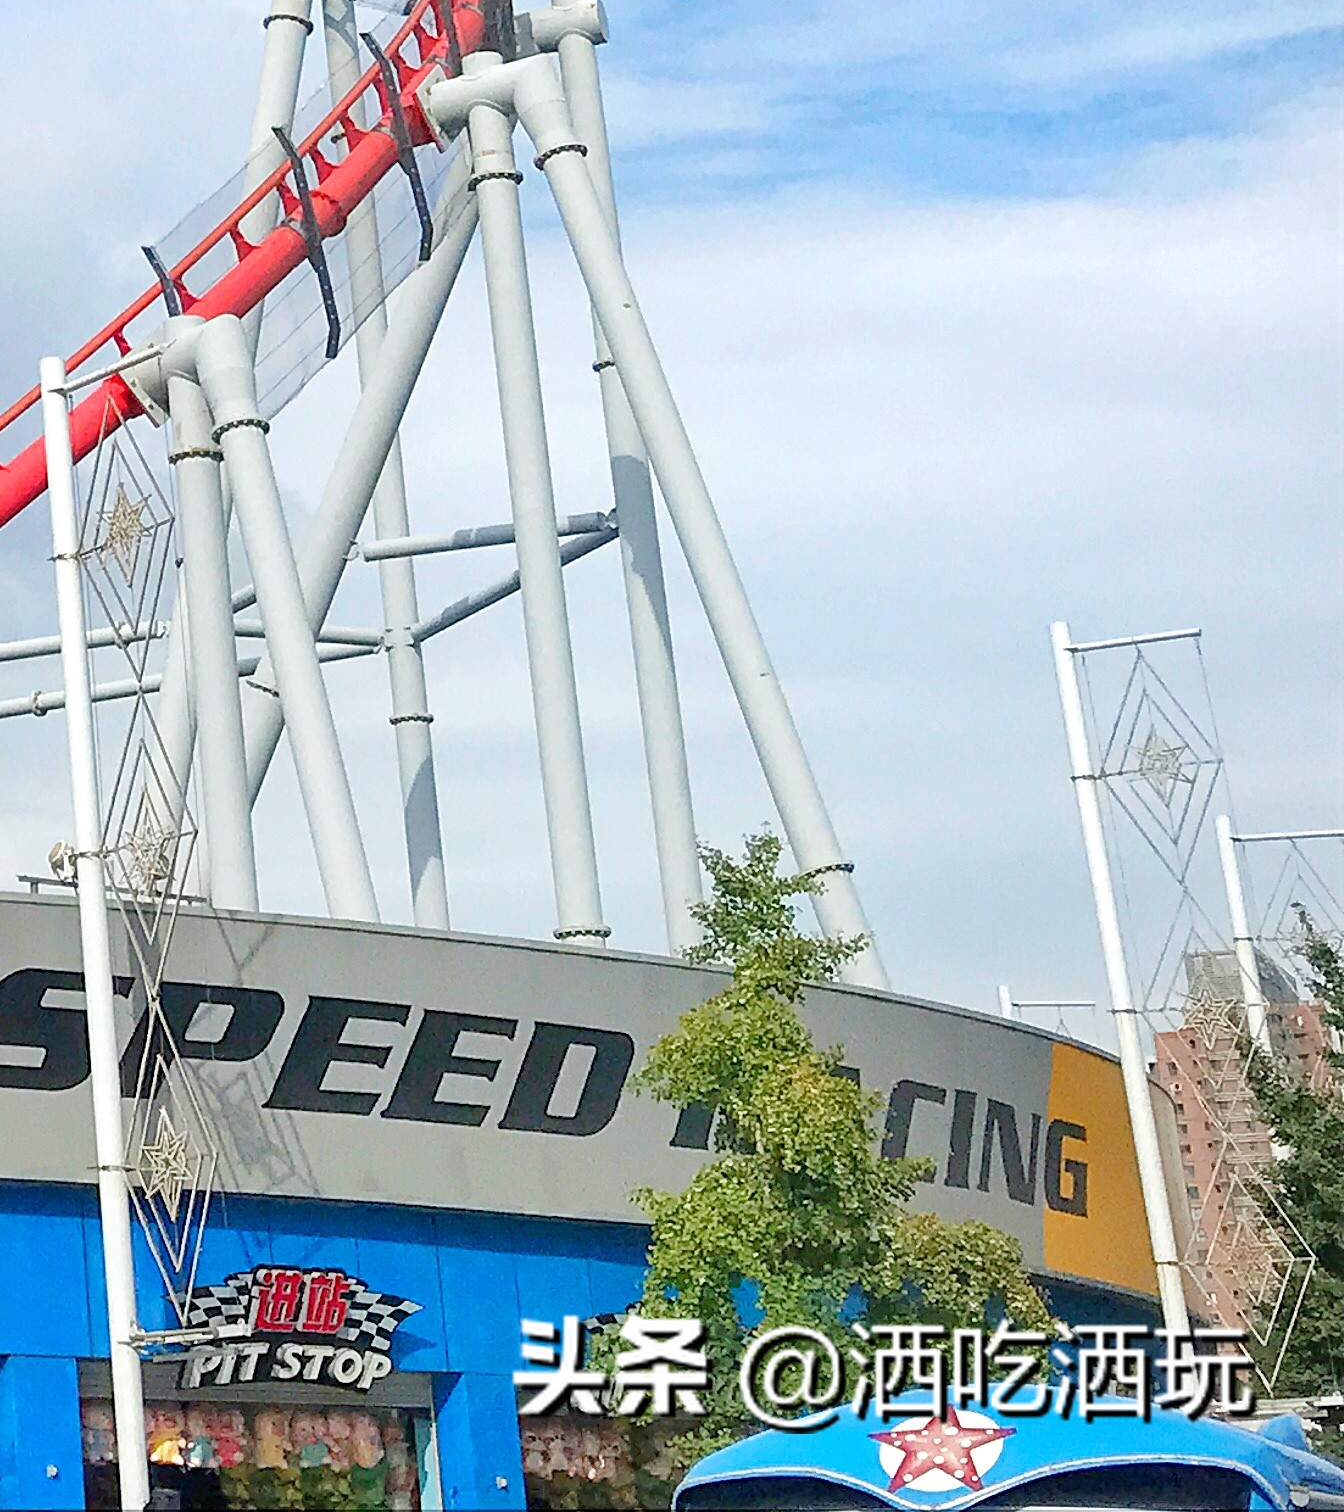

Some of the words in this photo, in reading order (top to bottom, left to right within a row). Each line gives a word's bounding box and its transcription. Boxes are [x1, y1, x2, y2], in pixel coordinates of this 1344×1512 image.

[253, 1268, 351, 1334] 进站
[180, 1342, 270, 1389] PIT
[270, 1341, 392, 1391] STOP
